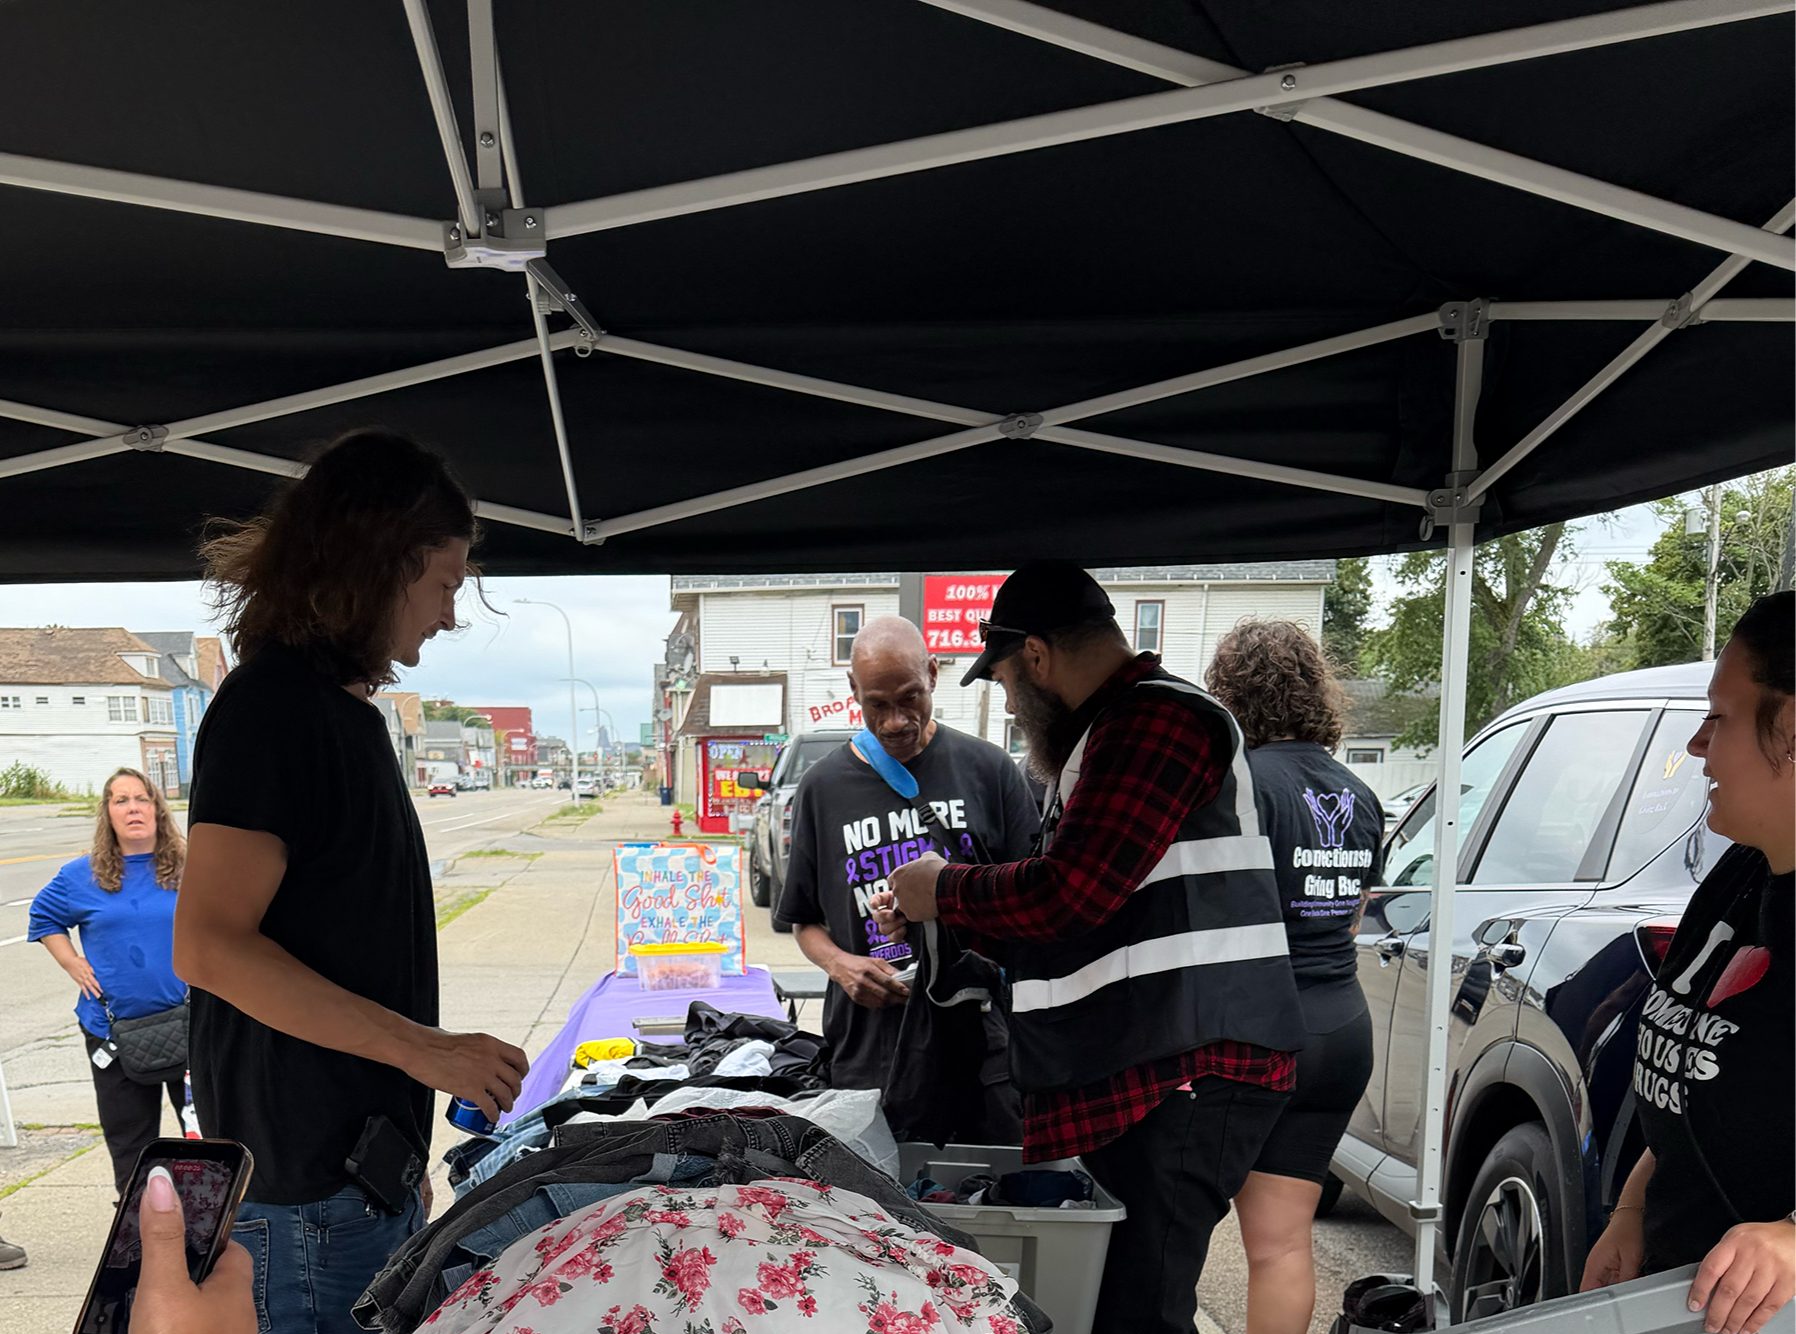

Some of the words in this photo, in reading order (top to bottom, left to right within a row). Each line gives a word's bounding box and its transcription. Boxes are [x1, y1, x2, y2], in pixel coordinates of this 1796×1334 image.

[945, 585, 990, 601] 100%
[928, 609, 962, 623] BEST
[709, 744, 743, 759] OPEN
[843, 816, 881, 855] NO
[888, 799, 968, 842] MORE
[641, 871, 684, 883] INHALE
[689, 871, 711, 882] THE
[622, 884, 680, 919] Good
[641, 917, 686, 928] EXHALE
[691, 916, 713, 928] THE
[1671, 920, 1735, 995] I
[1653, 1034, 1720, 1081] USES
[1634, 1061, 1689, 1114] RUGS
